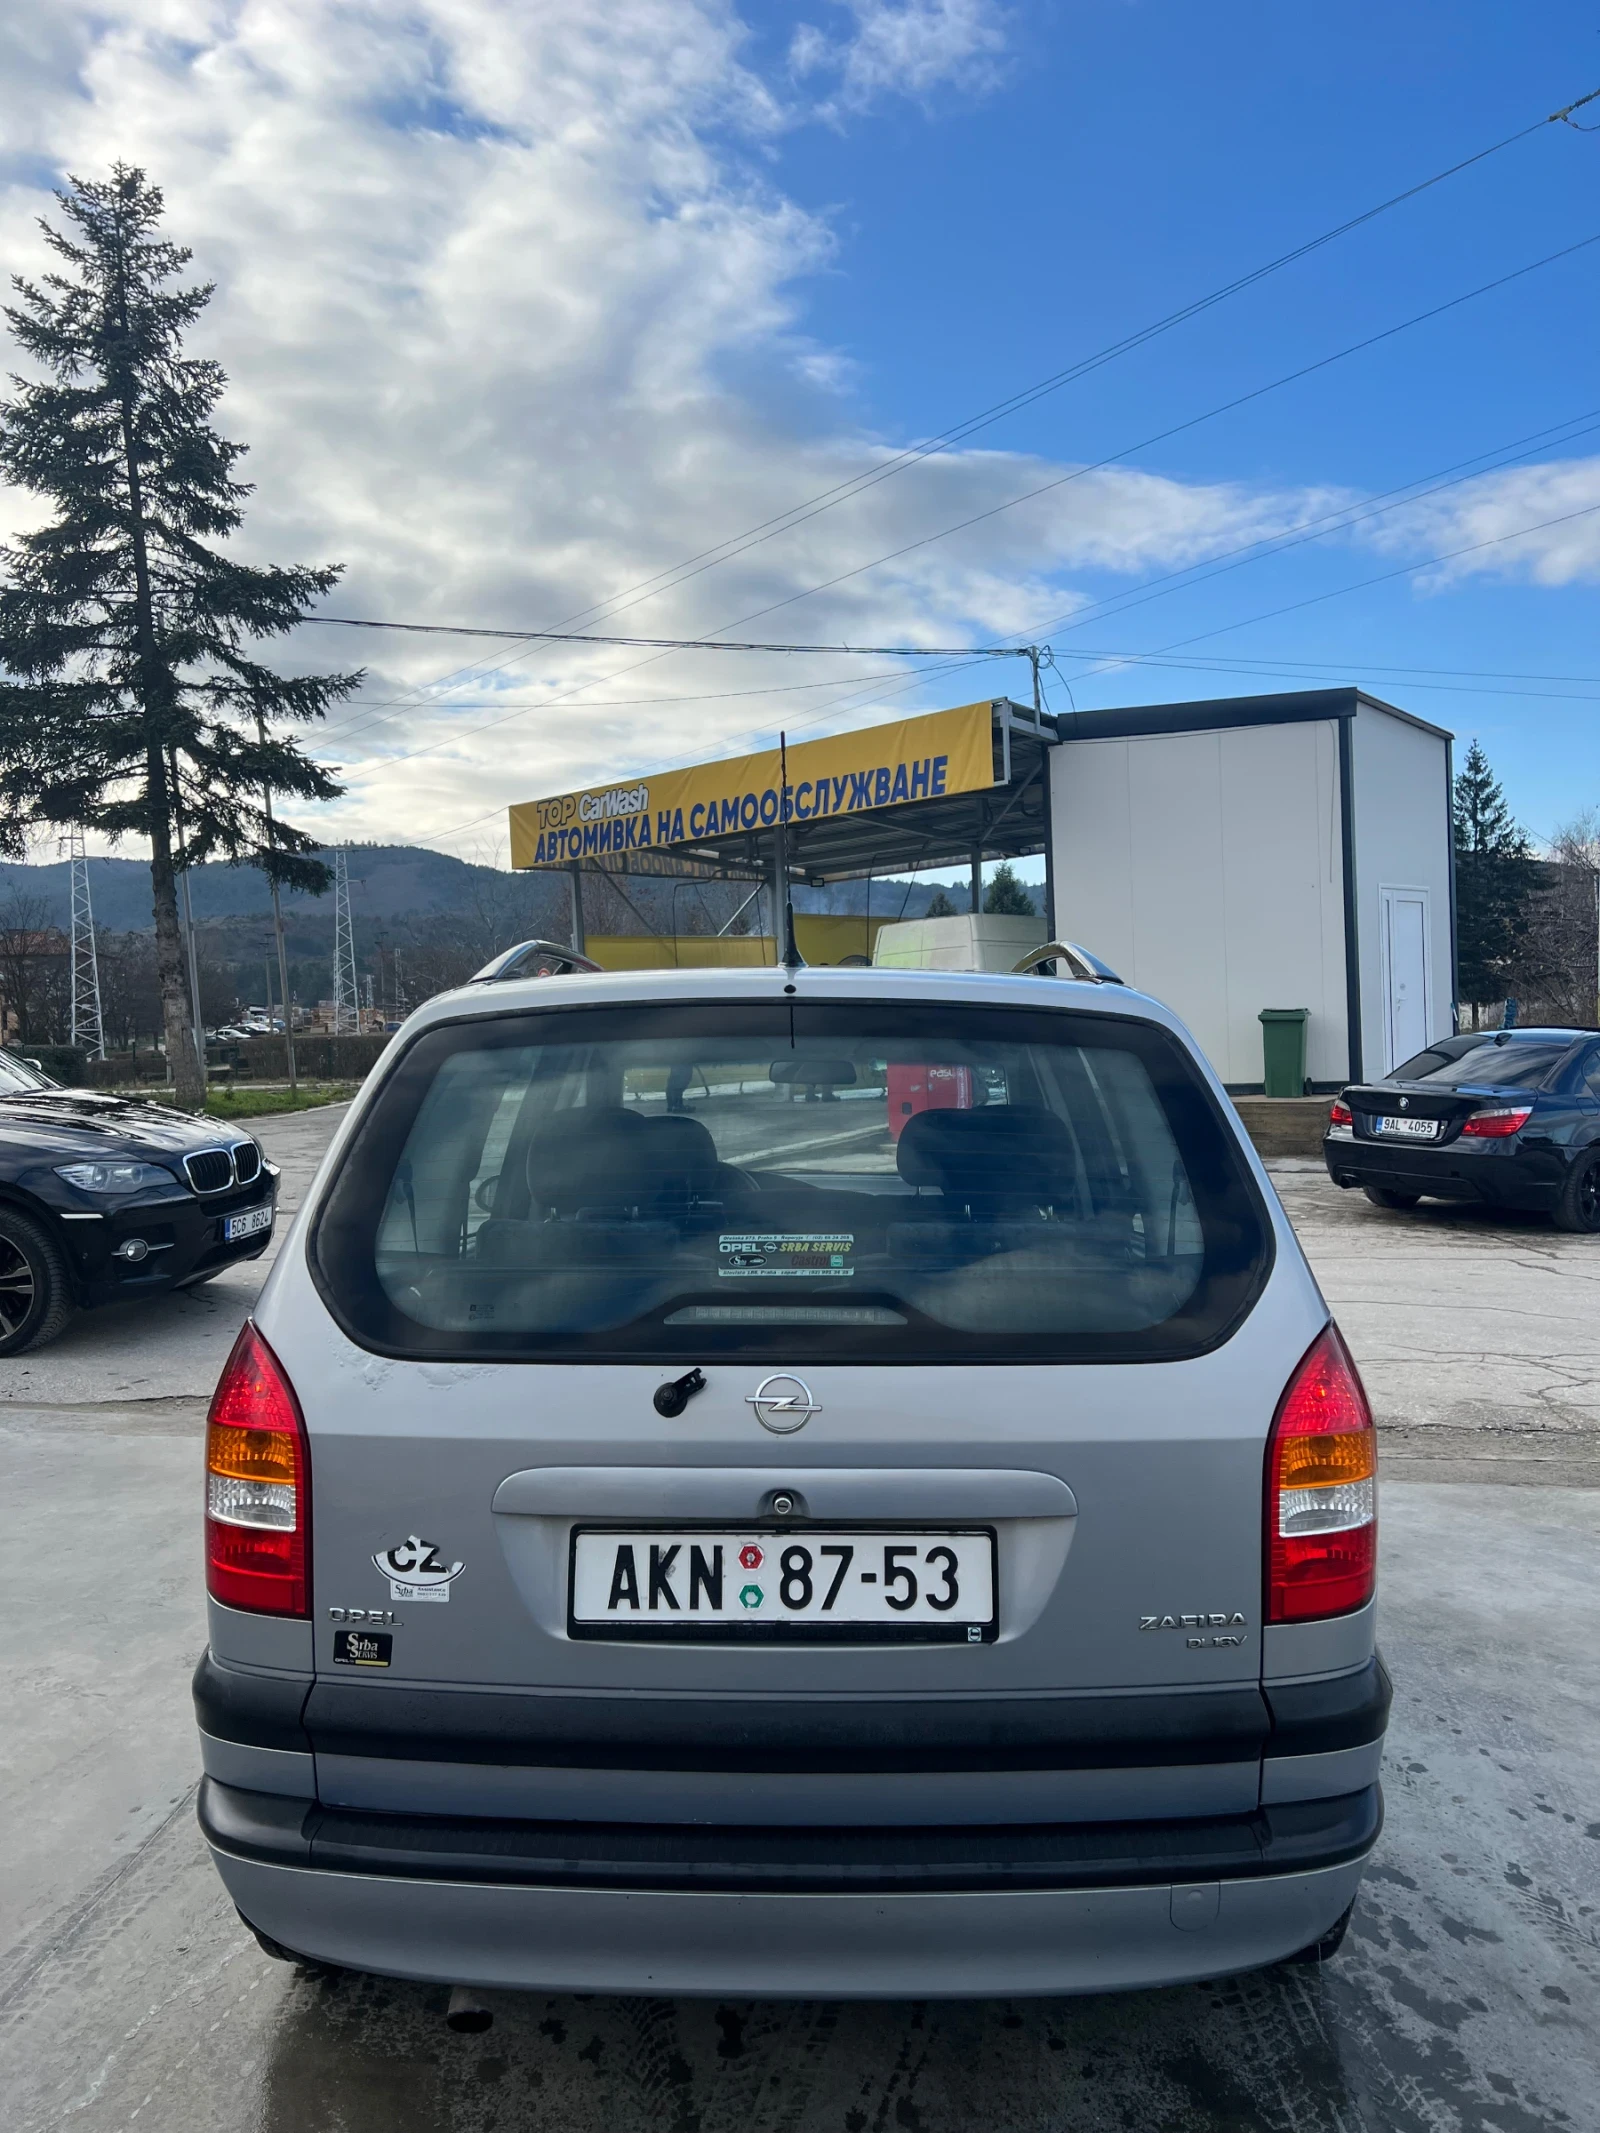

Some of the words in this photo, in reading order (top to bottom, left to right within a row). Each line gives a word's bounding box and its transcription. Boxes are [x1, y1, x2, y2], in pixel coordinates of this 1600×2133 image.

[534, 814, 652, 863] АВТОМИВКА
[657, 807, 685, 844] НА
[689, 755, 949, 838] САМООБСЛУЖВАНЕ
[537, 796, 576, 829] TOP
[578, 783, 649, 822] CarWash
[1384, 1118, 1400, 1130] 9AL
[1408, 1121, 1433, 1133] 4055
[232, 1217, 247, 1235] 5C6
[252, 1210, 268, 1228] 8624
[719, 1243, 761, 1252] OPEL
[779, 1242, 809, 1252] SRBA
[811, 1242, 852, 1252] SERVIS
[387, 1540, 447, 1573] CZ
[607, 1544, 723, 1610] AKN
[779, 1545, 959, 1611] 87-53
[328, 1607, 404, 1626] OPEL
[1139, 1613, 1248, 1630] ZAFIRA
[347, 1633, 378, 1651] Srba
